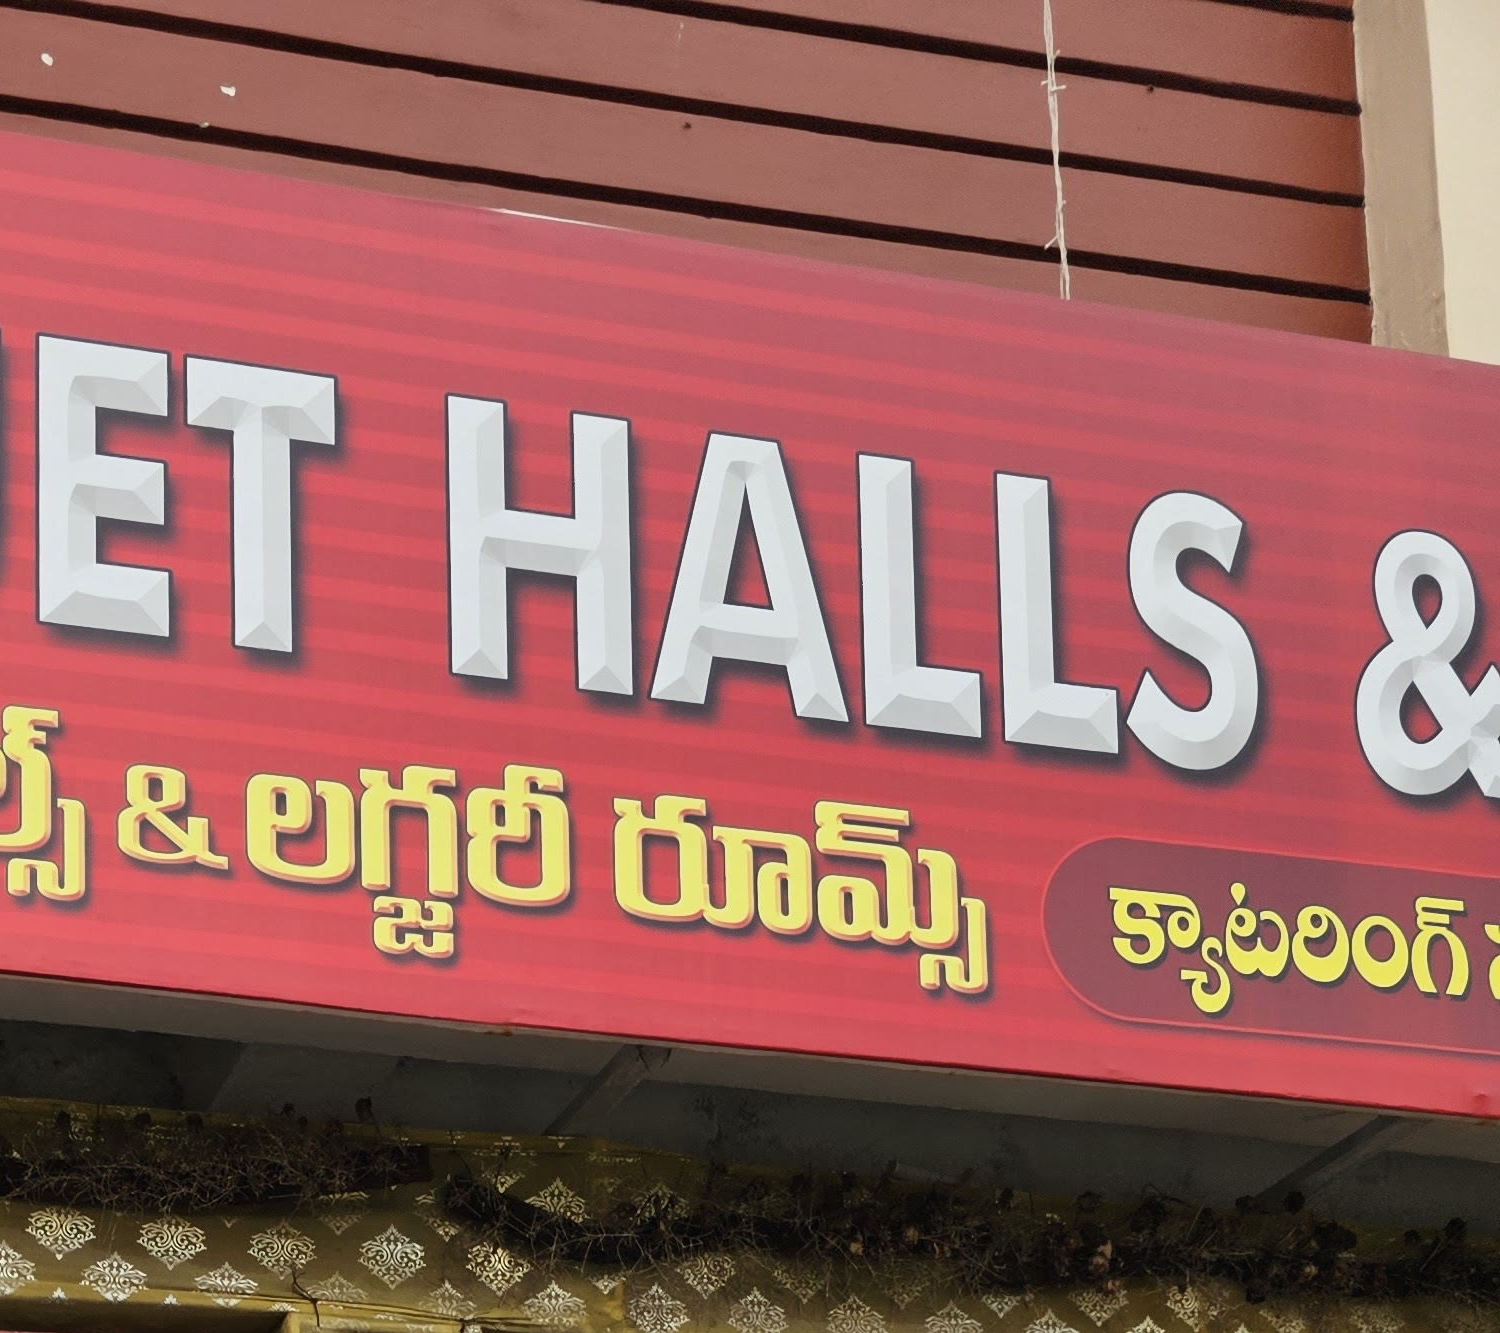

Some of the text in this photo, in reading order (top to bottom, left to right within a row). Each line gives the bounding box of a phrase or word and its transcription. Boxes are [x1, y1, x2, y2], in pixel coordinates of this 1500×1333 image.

[446, 394, 1259, 770] HALLS
[117, 764, 229, 870] &
[245, 763, 571, 958] లగ్జరీ
[613, 794, 990, 993] రూమ్స్
[1109, 882, 1469, 1013] క్యాటరింగ్
